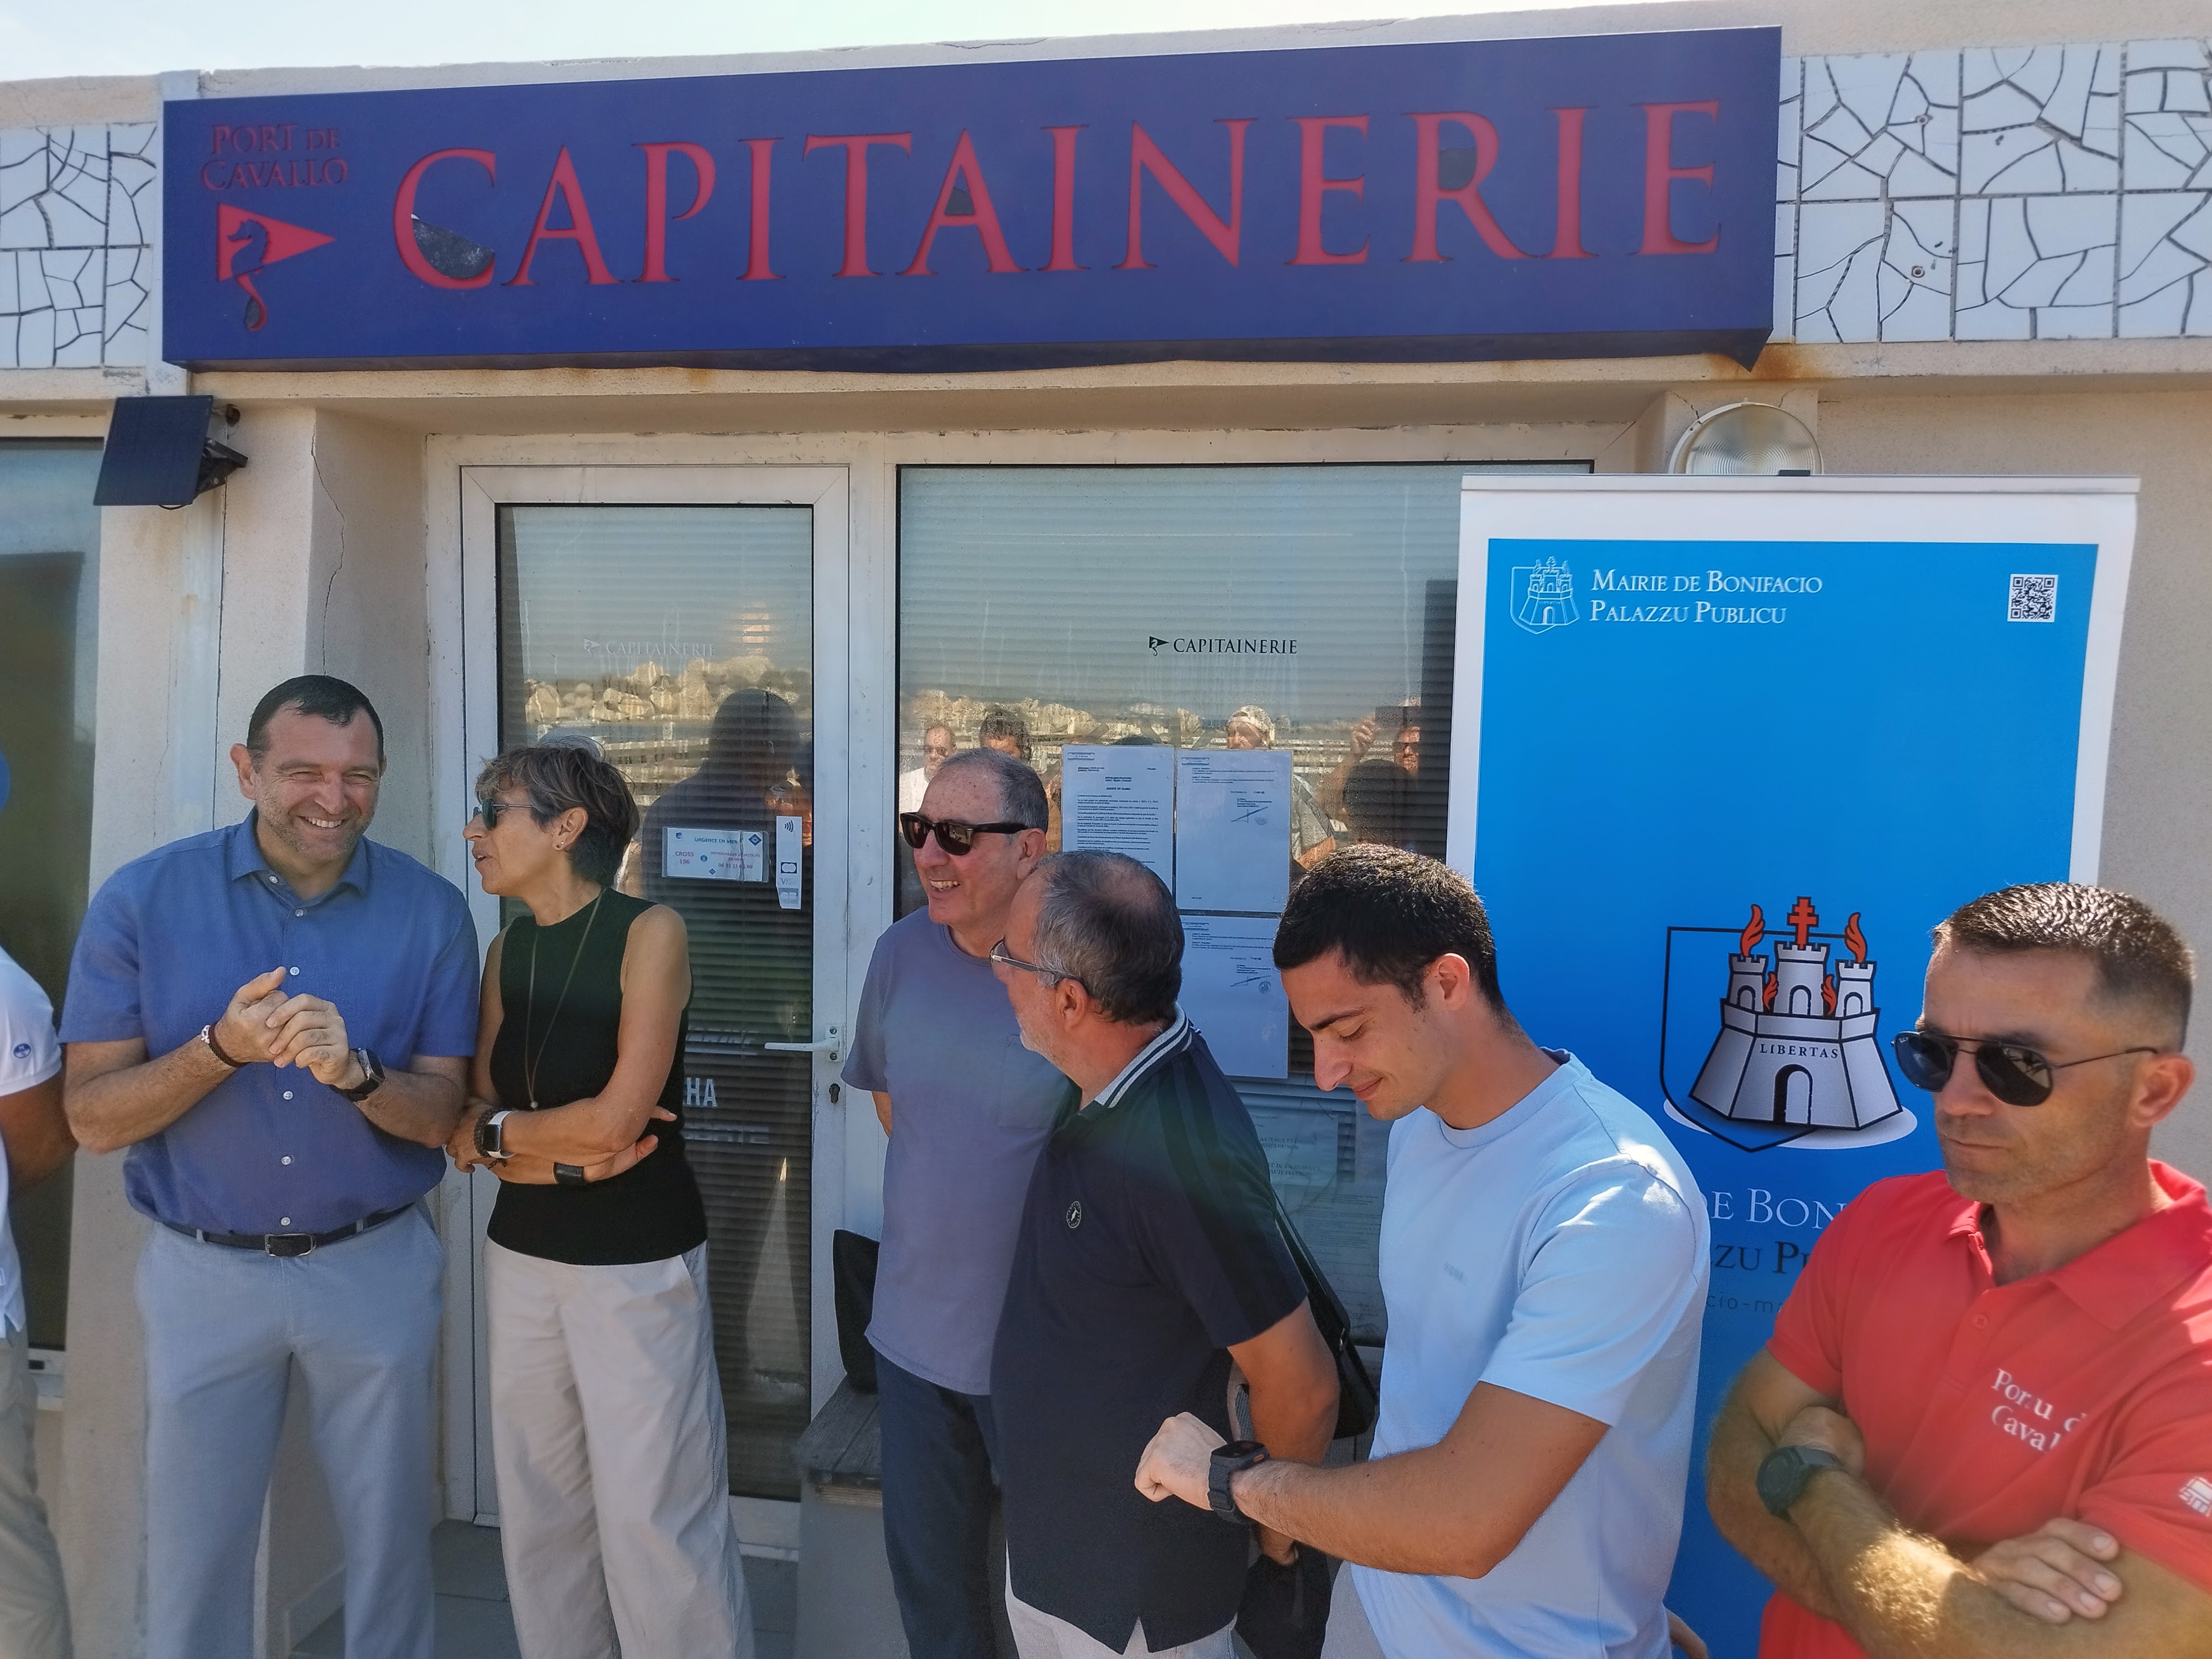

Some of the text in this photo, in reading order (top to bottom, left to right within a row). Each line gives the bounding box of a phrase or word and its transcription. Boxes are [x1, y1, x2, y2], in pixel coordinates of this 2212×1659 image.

[211, 123, 341, 154] PORT DE
[201, 157, 349, 191] CAVALLO
[393, 98, 1721, 290] CAPITAINERIE
[1590, 568, 1823, 594] MAIRIE DE BONIFACIO
[1588, 599, 1788, 624] PALAZZU PUBLICU
[606, 640, 716, 657] CAPITAINERIE
[1173, 638, 1297, 654] CAPITAINERIE
[1759, 1043, 1839, 1059] LIBERTAS
[1710, 1244, 1763, 1271] ZU
[1706, 1291, 1783, 1313] cio-m
[1991, 1368, 2054, 1421] Poru
